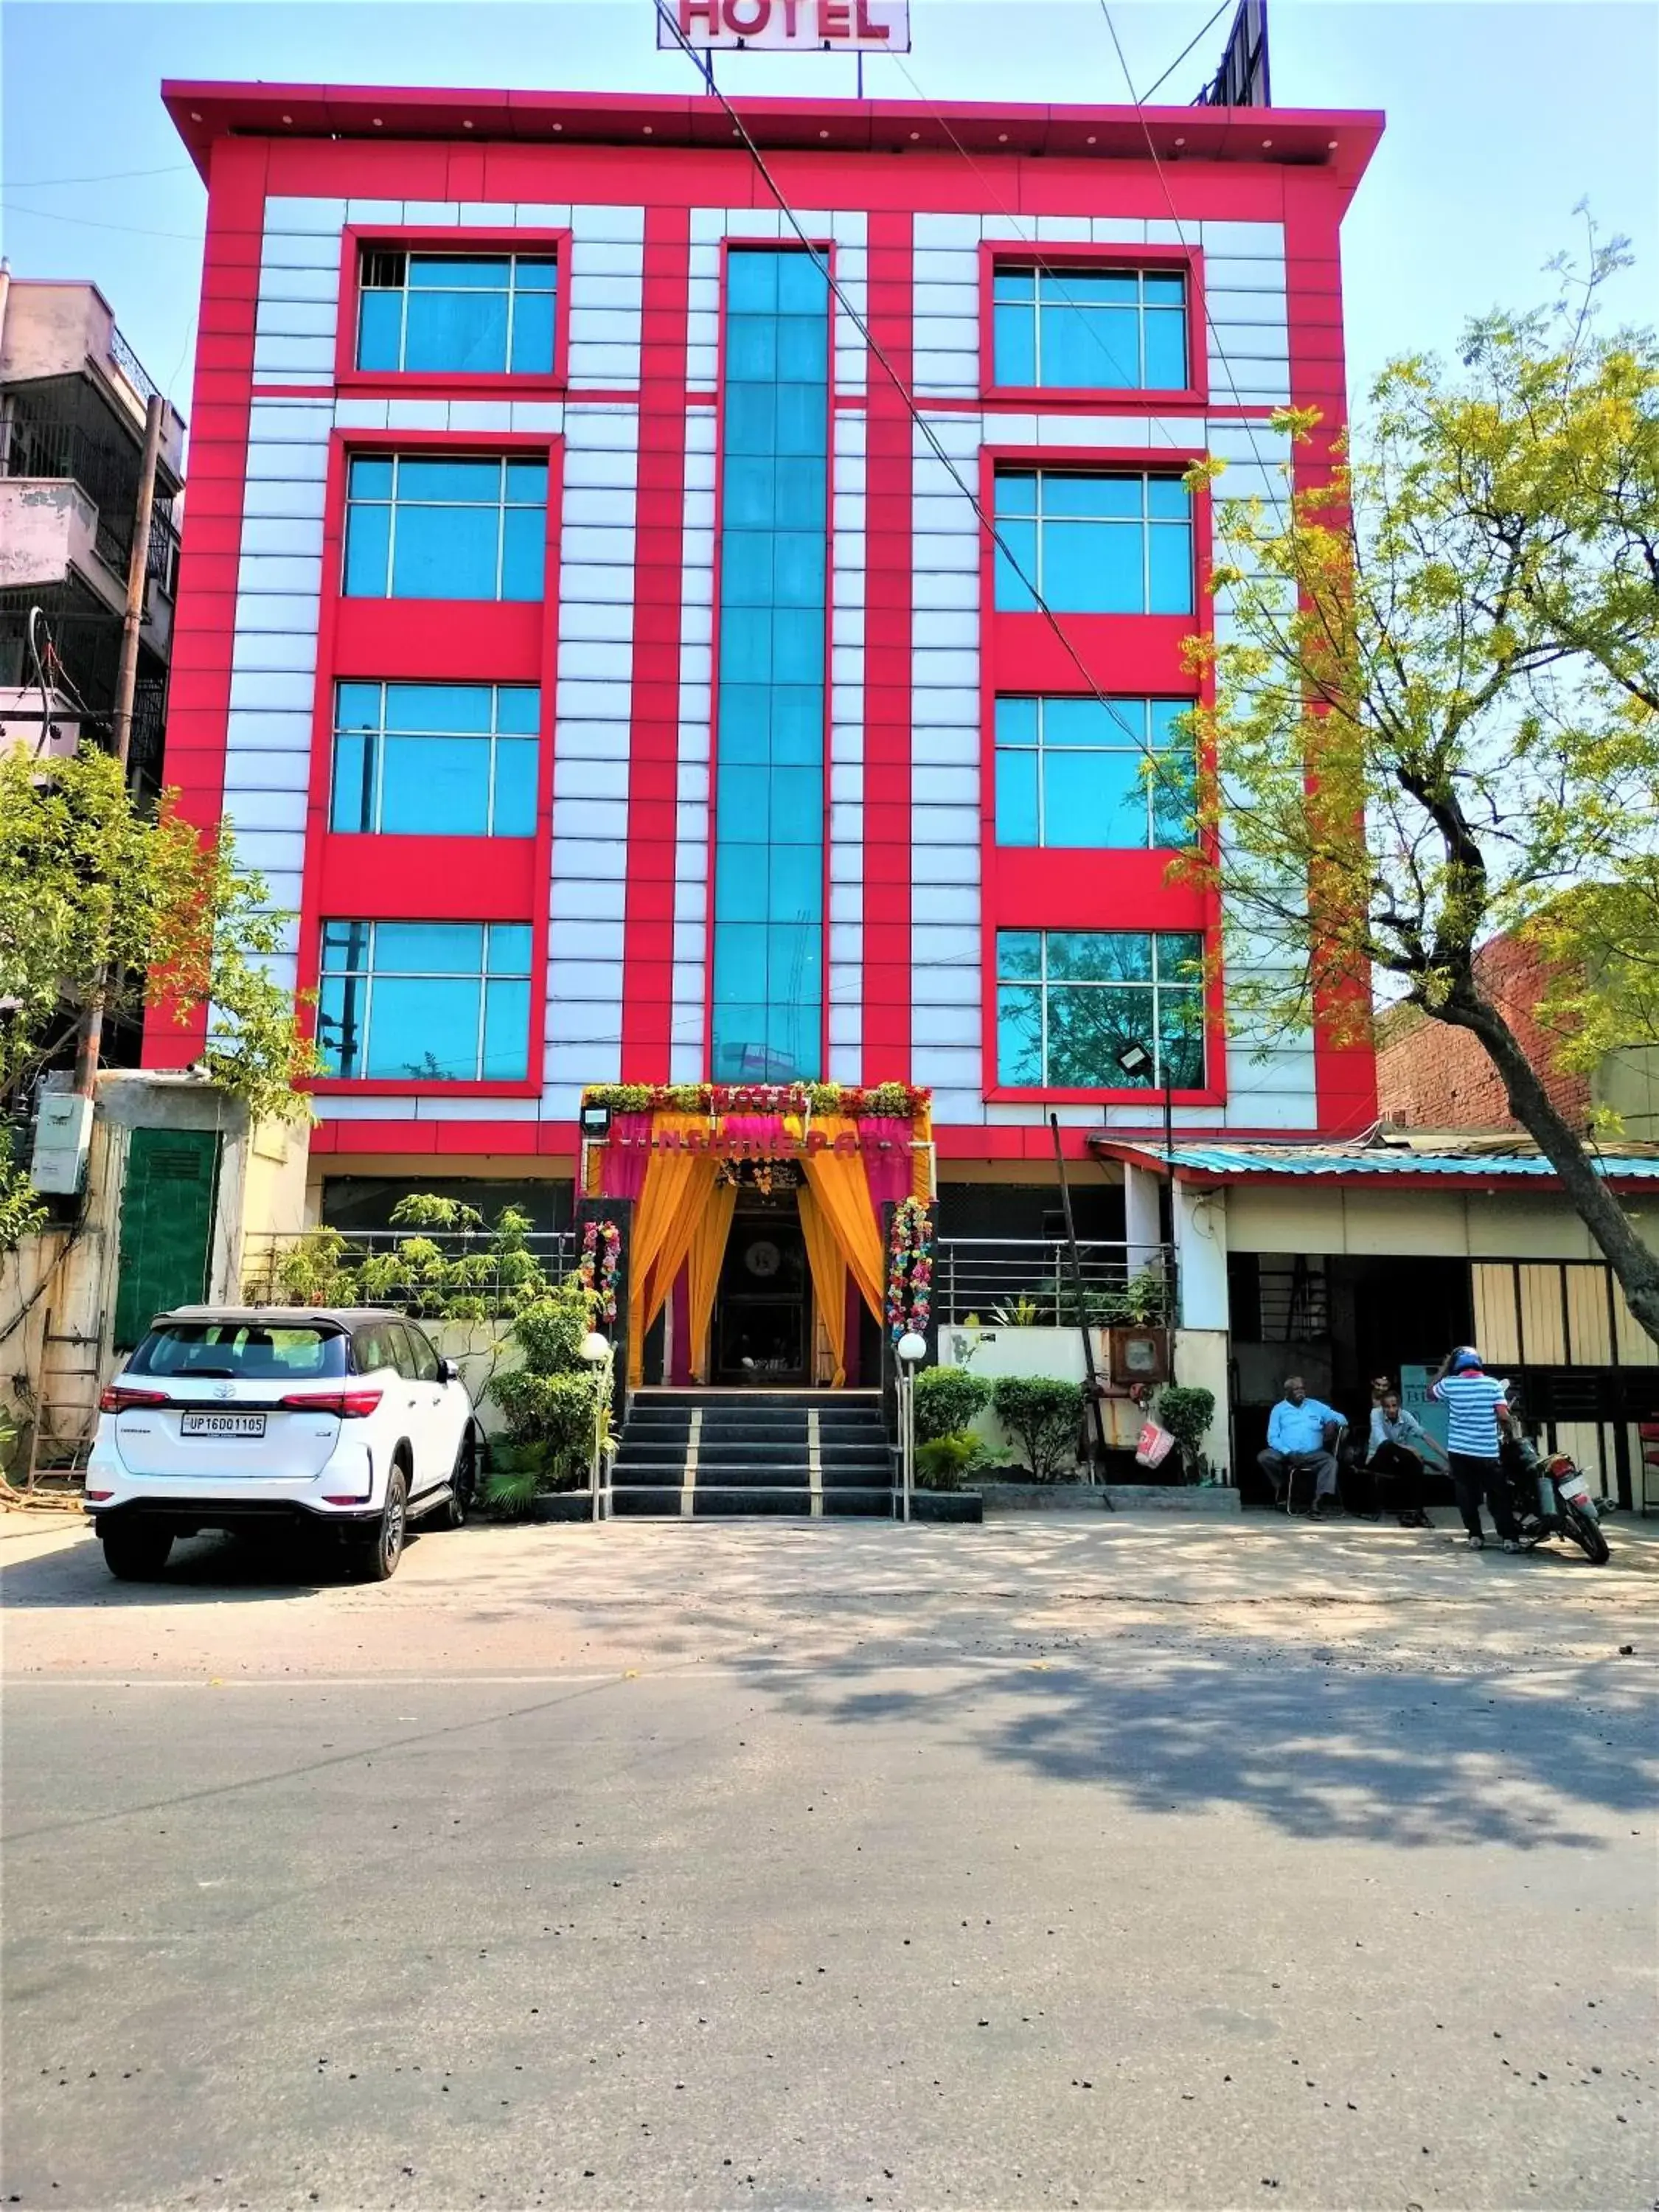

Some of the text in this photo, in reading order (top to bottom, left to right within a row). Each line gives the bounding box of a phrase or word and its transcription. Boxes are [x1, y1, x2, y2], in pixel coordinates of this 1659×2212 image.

[680, 0, 889, 38] HOTEL
[713, 1090, 807, 1113] HOTEL
[608, 1127, 914, 1160] SUNSHINE PARK
